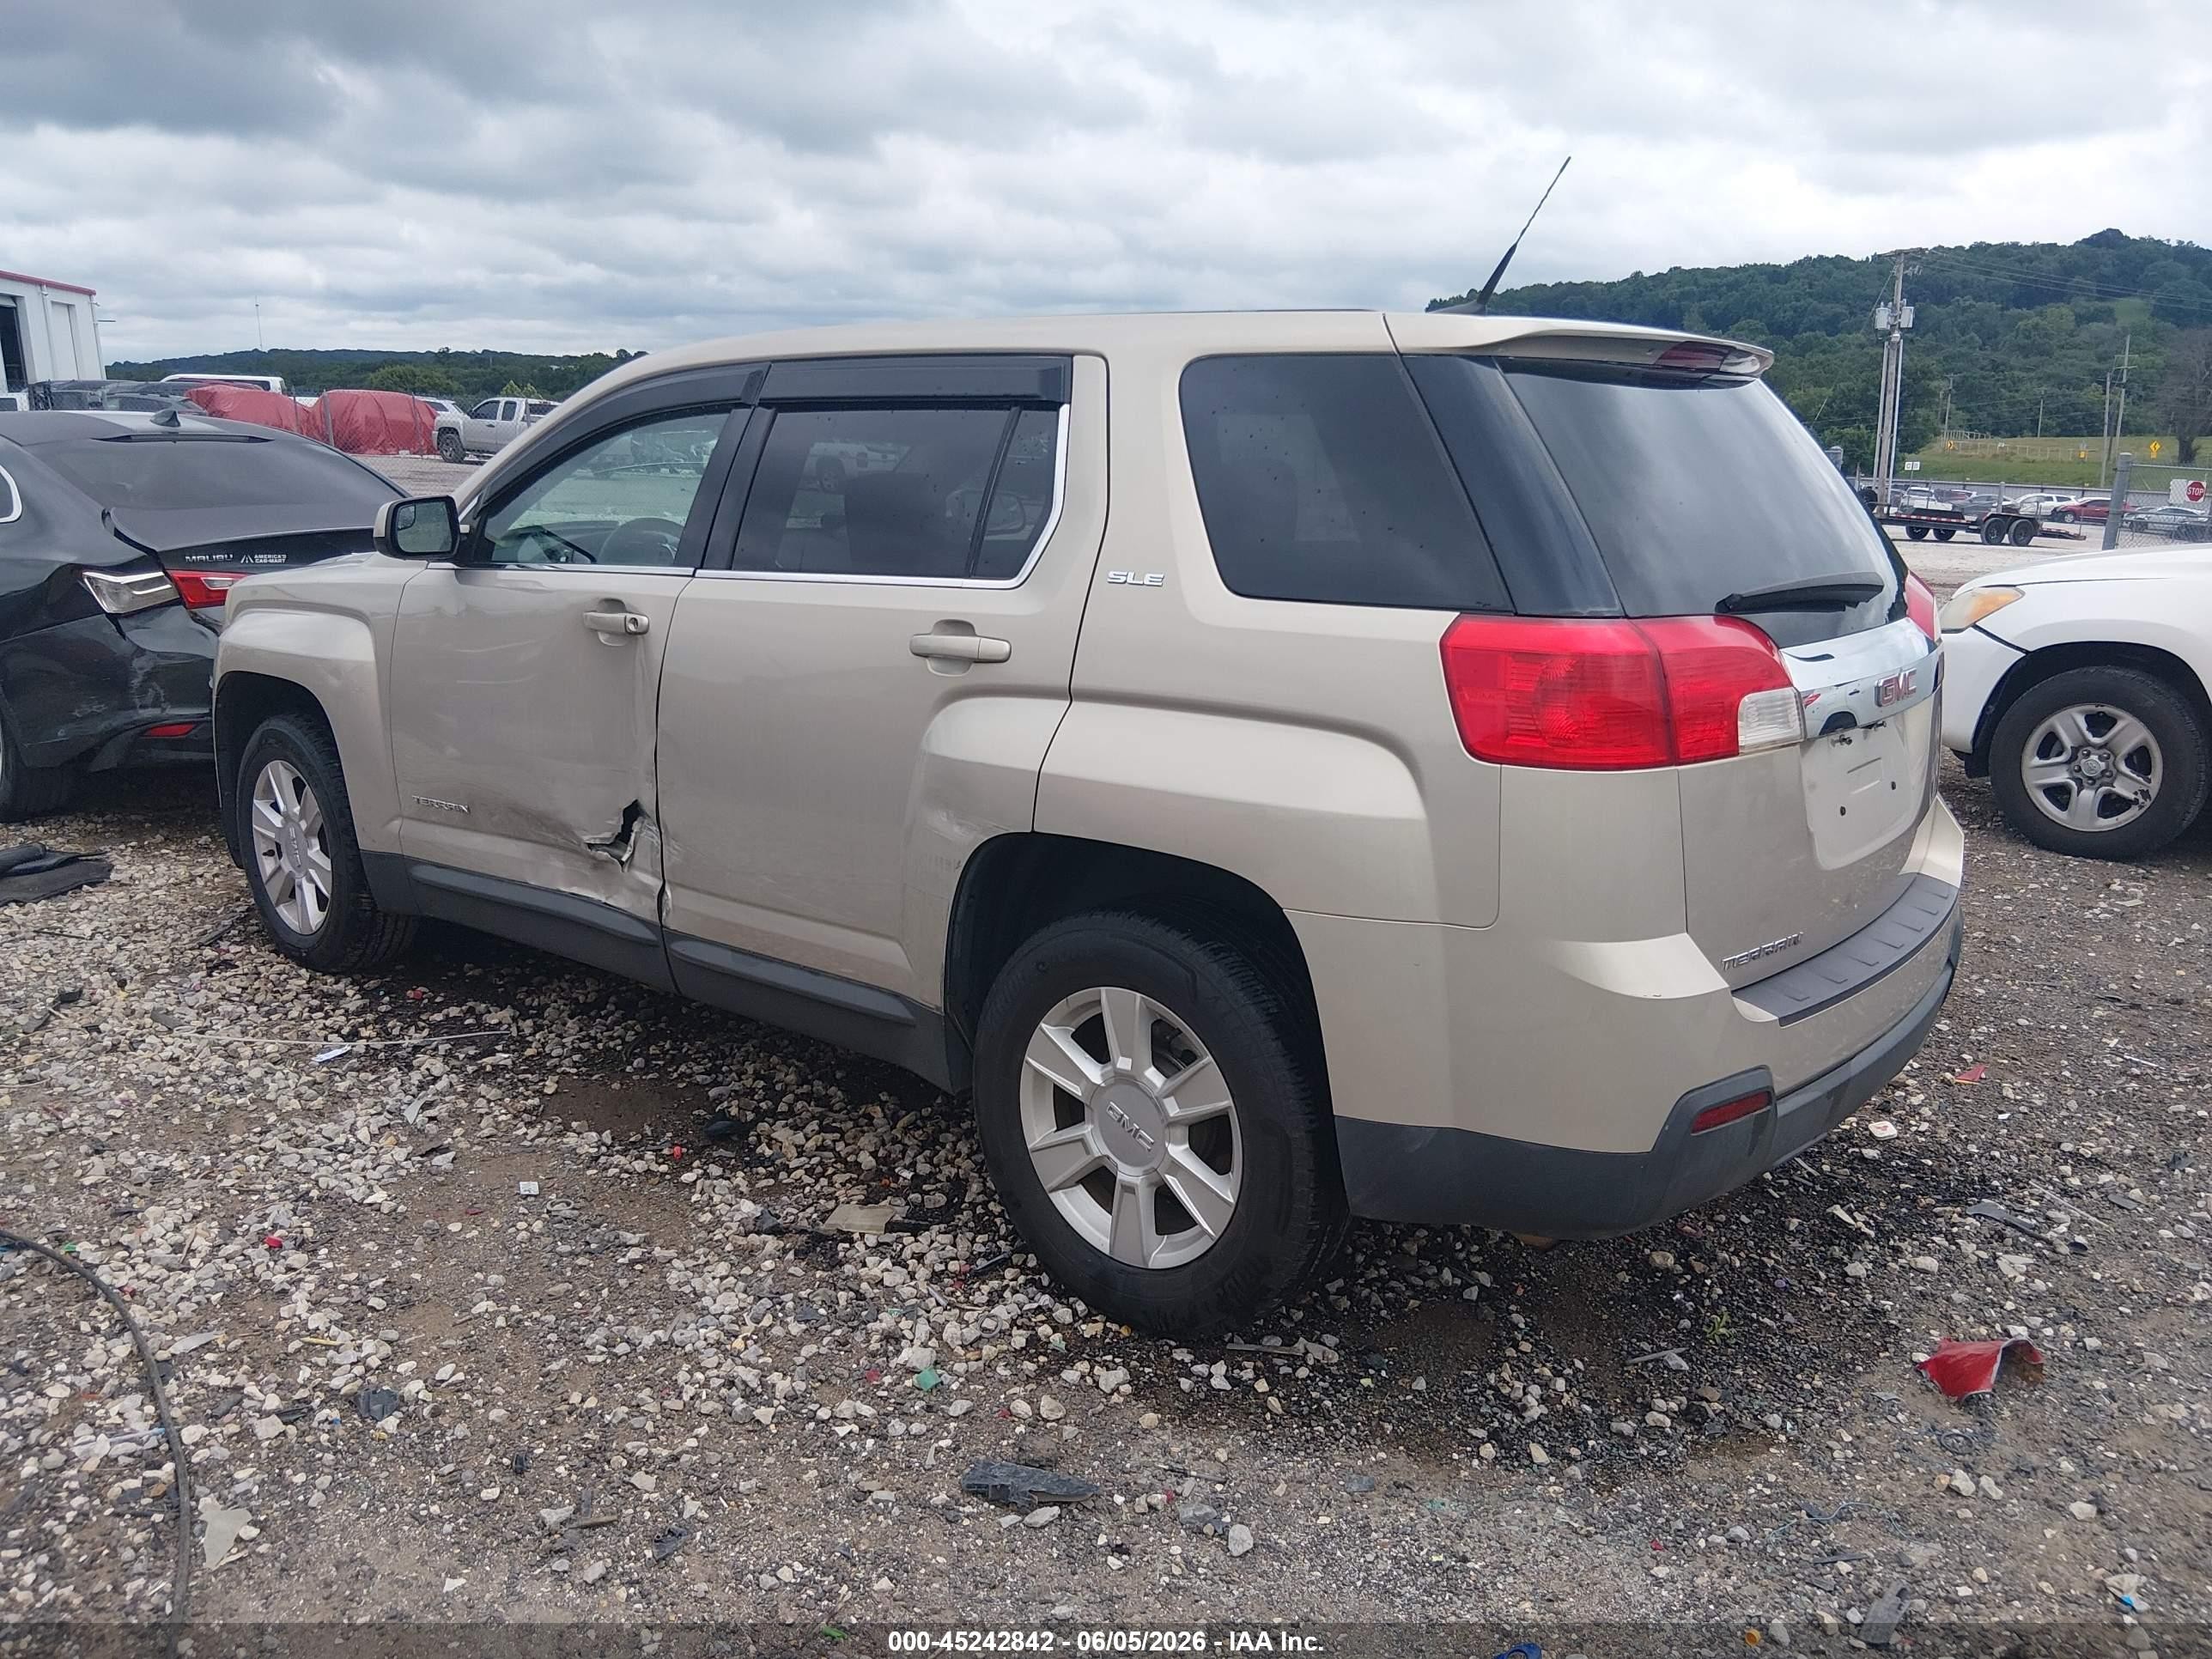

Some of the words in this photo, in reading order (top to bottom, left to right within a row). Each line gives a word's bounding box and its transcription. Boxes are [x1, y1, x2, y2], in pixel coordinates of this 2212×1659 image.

[2187, 487, 2204, 496] STOP
[185, 554, 234, 563] MALIBU
[1107, 571, 1164, 586] SLE
[1875, 667, 1917, 707] GMC
[412, 795, 471, 815] TERRAIN
[1721, 931, 1804, 970] TERRAIN
[1106, 1101, 1155, 1152] GMC
